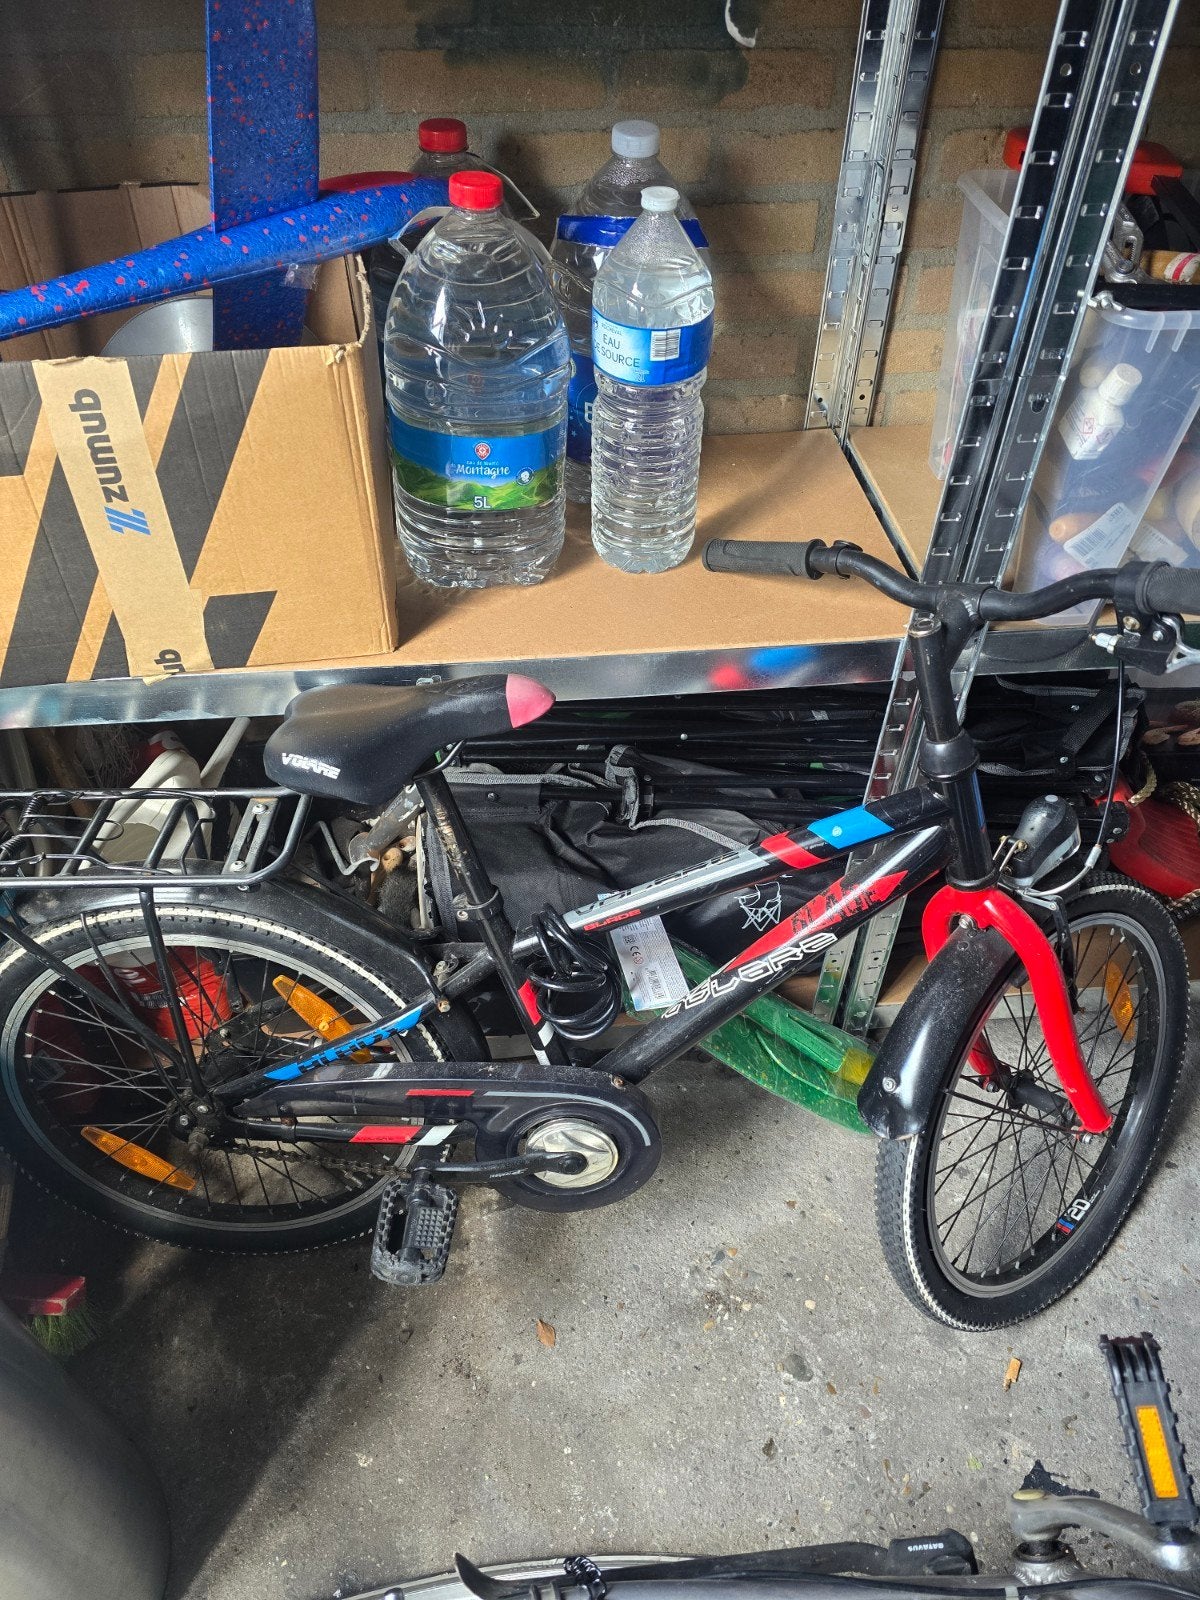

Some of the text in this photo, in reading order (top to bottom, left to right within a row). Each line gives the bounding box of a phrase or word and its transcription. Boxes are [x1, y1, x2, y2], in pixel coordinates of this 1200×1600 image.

[603, 333, 621, 350] EAU
[601, 346, 641, 368] SOURCE
[69, 388, 129, 504] zumub
[456, 463, 510, 480] Montagne
[474, 497, 491, 508] 5L
[1067, 1198, 1091, 1221] 20
[907, 1542, 944, 1552] BATAVUS
